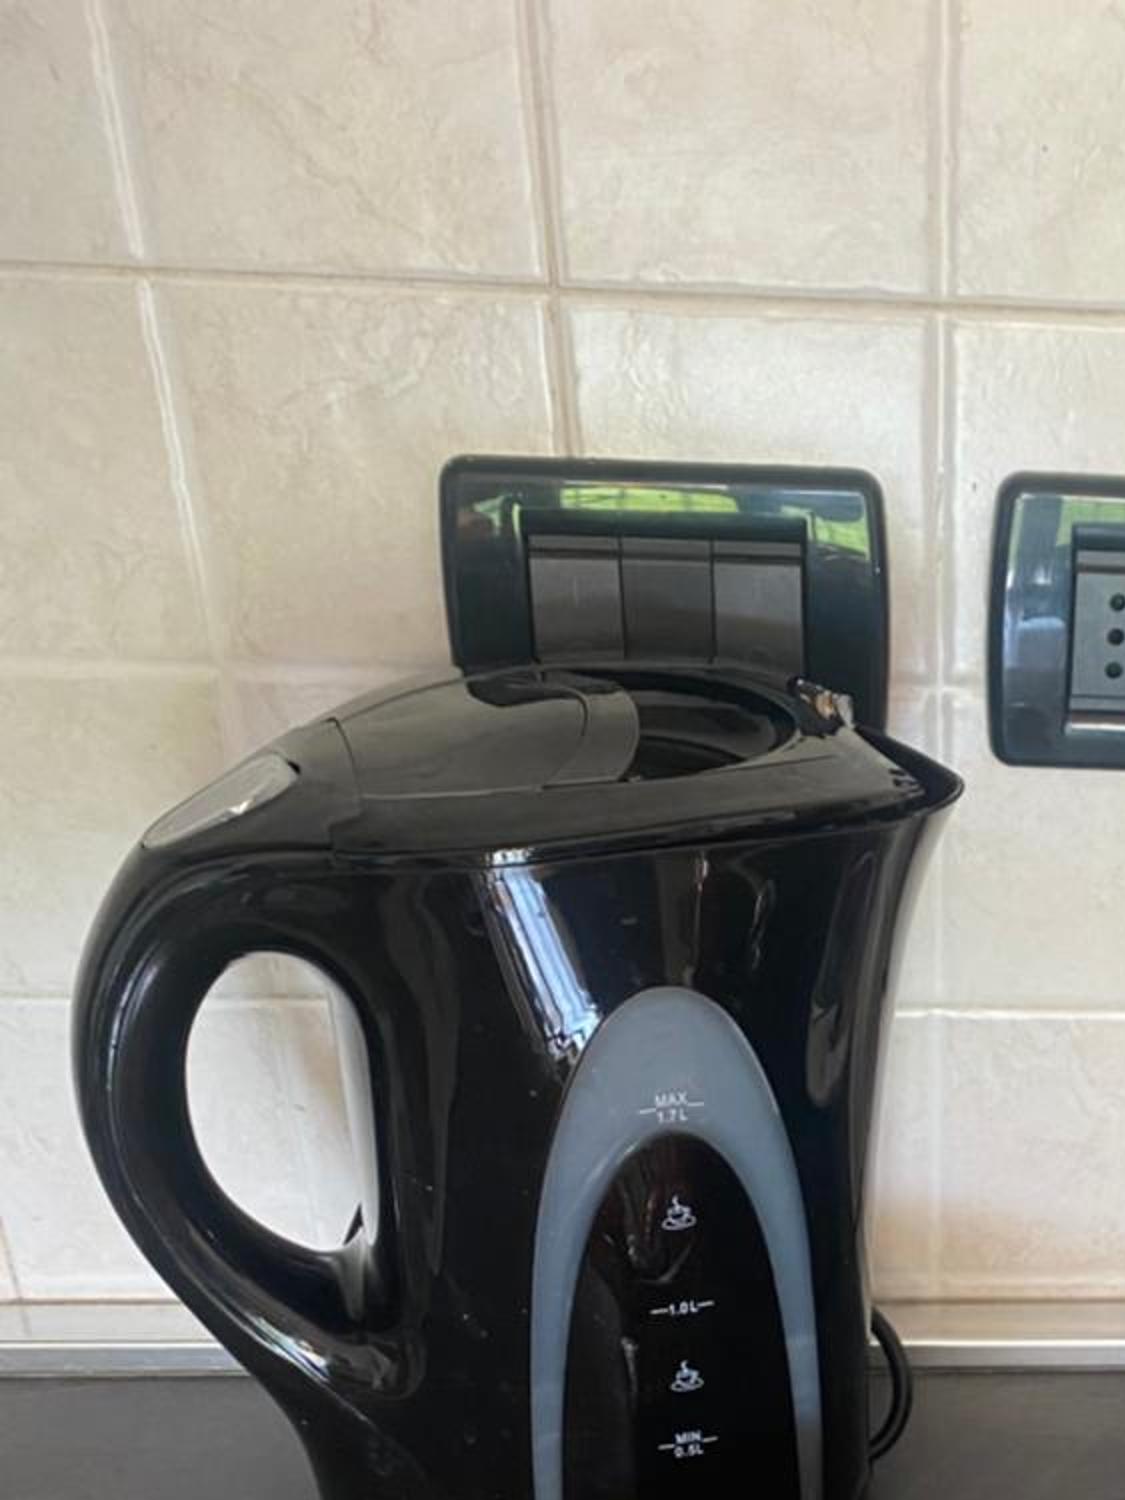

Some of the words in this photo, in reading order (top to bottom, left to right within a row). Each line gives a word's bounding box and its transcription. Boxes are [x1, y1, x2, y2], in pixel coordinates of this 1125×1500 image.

[656, 1091, 688, 1107] MAX
[669, 1300, 698, 1316] 1.0L
[675, 1430, 702, 1444] MIN
